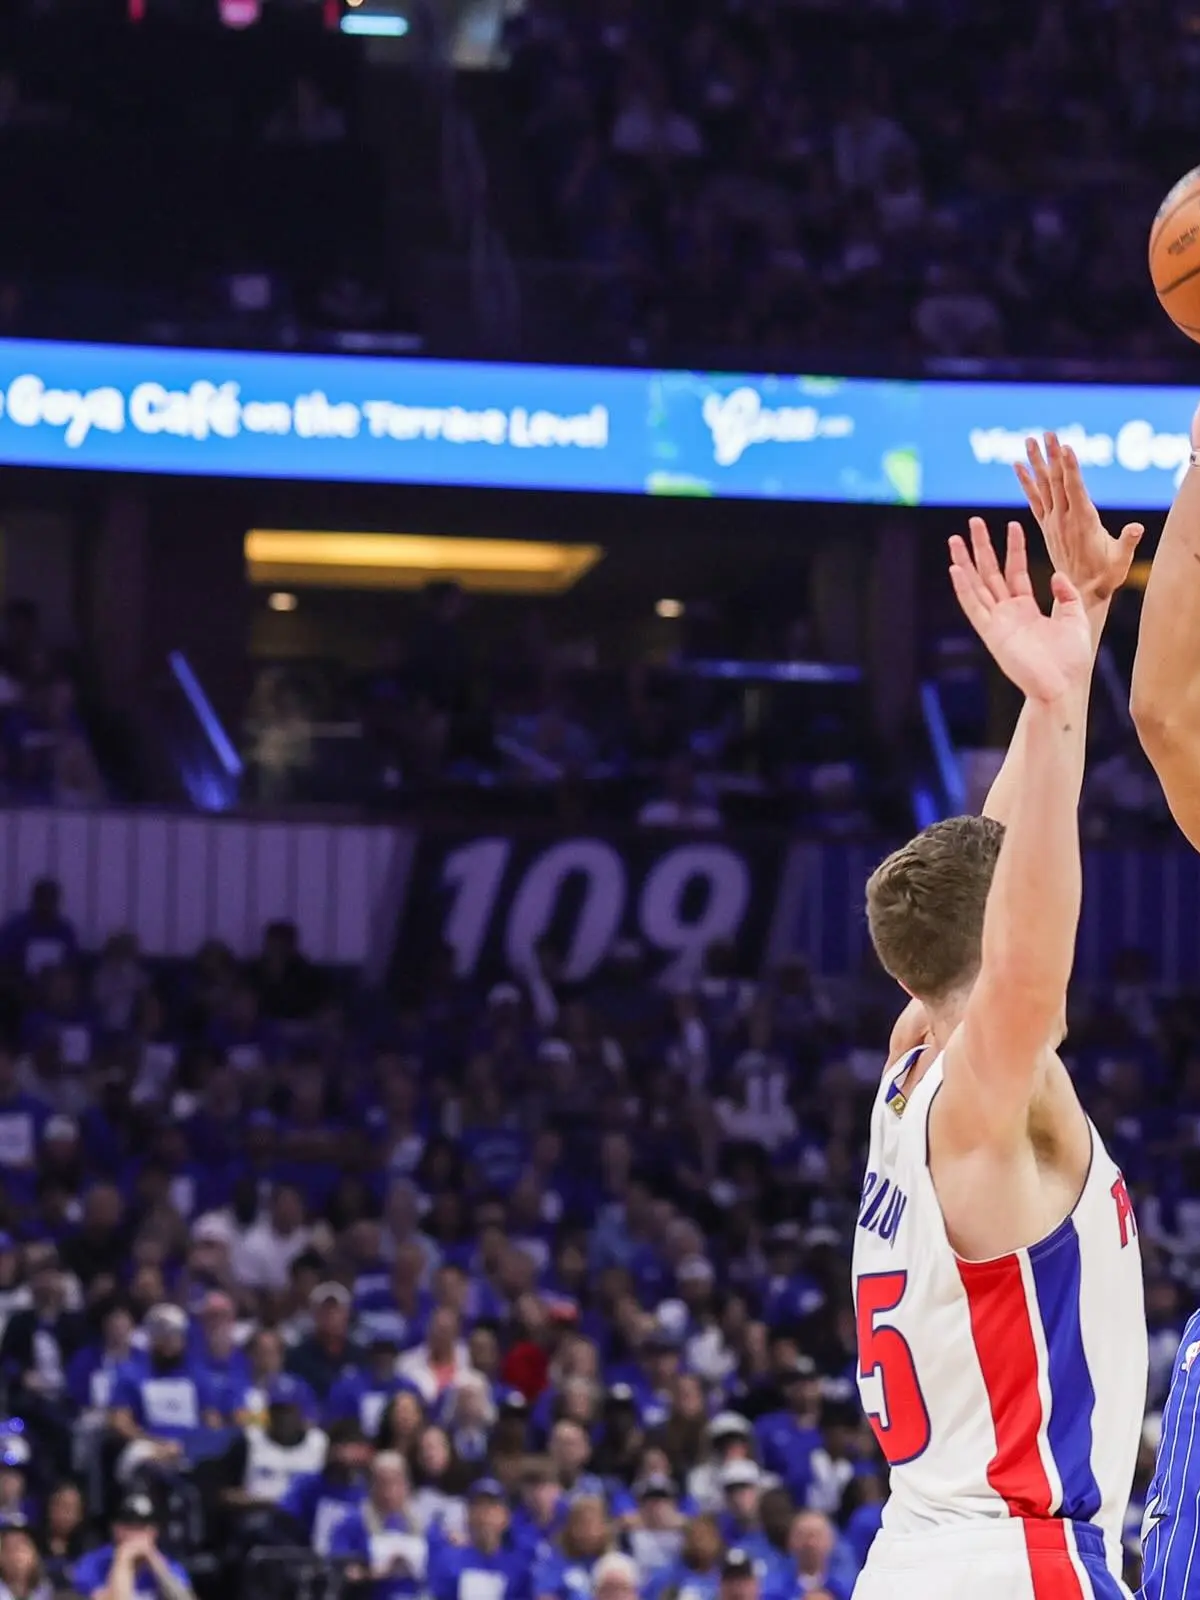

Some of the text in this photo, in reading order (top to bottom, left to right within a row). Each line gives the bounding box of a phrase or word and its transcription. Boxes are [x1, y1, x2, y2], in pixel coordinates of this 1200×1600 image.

[294, 390, 360, 439] the
[362, 400, 507, 446] Terrace
[510, 404, 609, 449] Level
[443, 837, 752, 992] 109
[856, 1269, 931, 1467] 5
